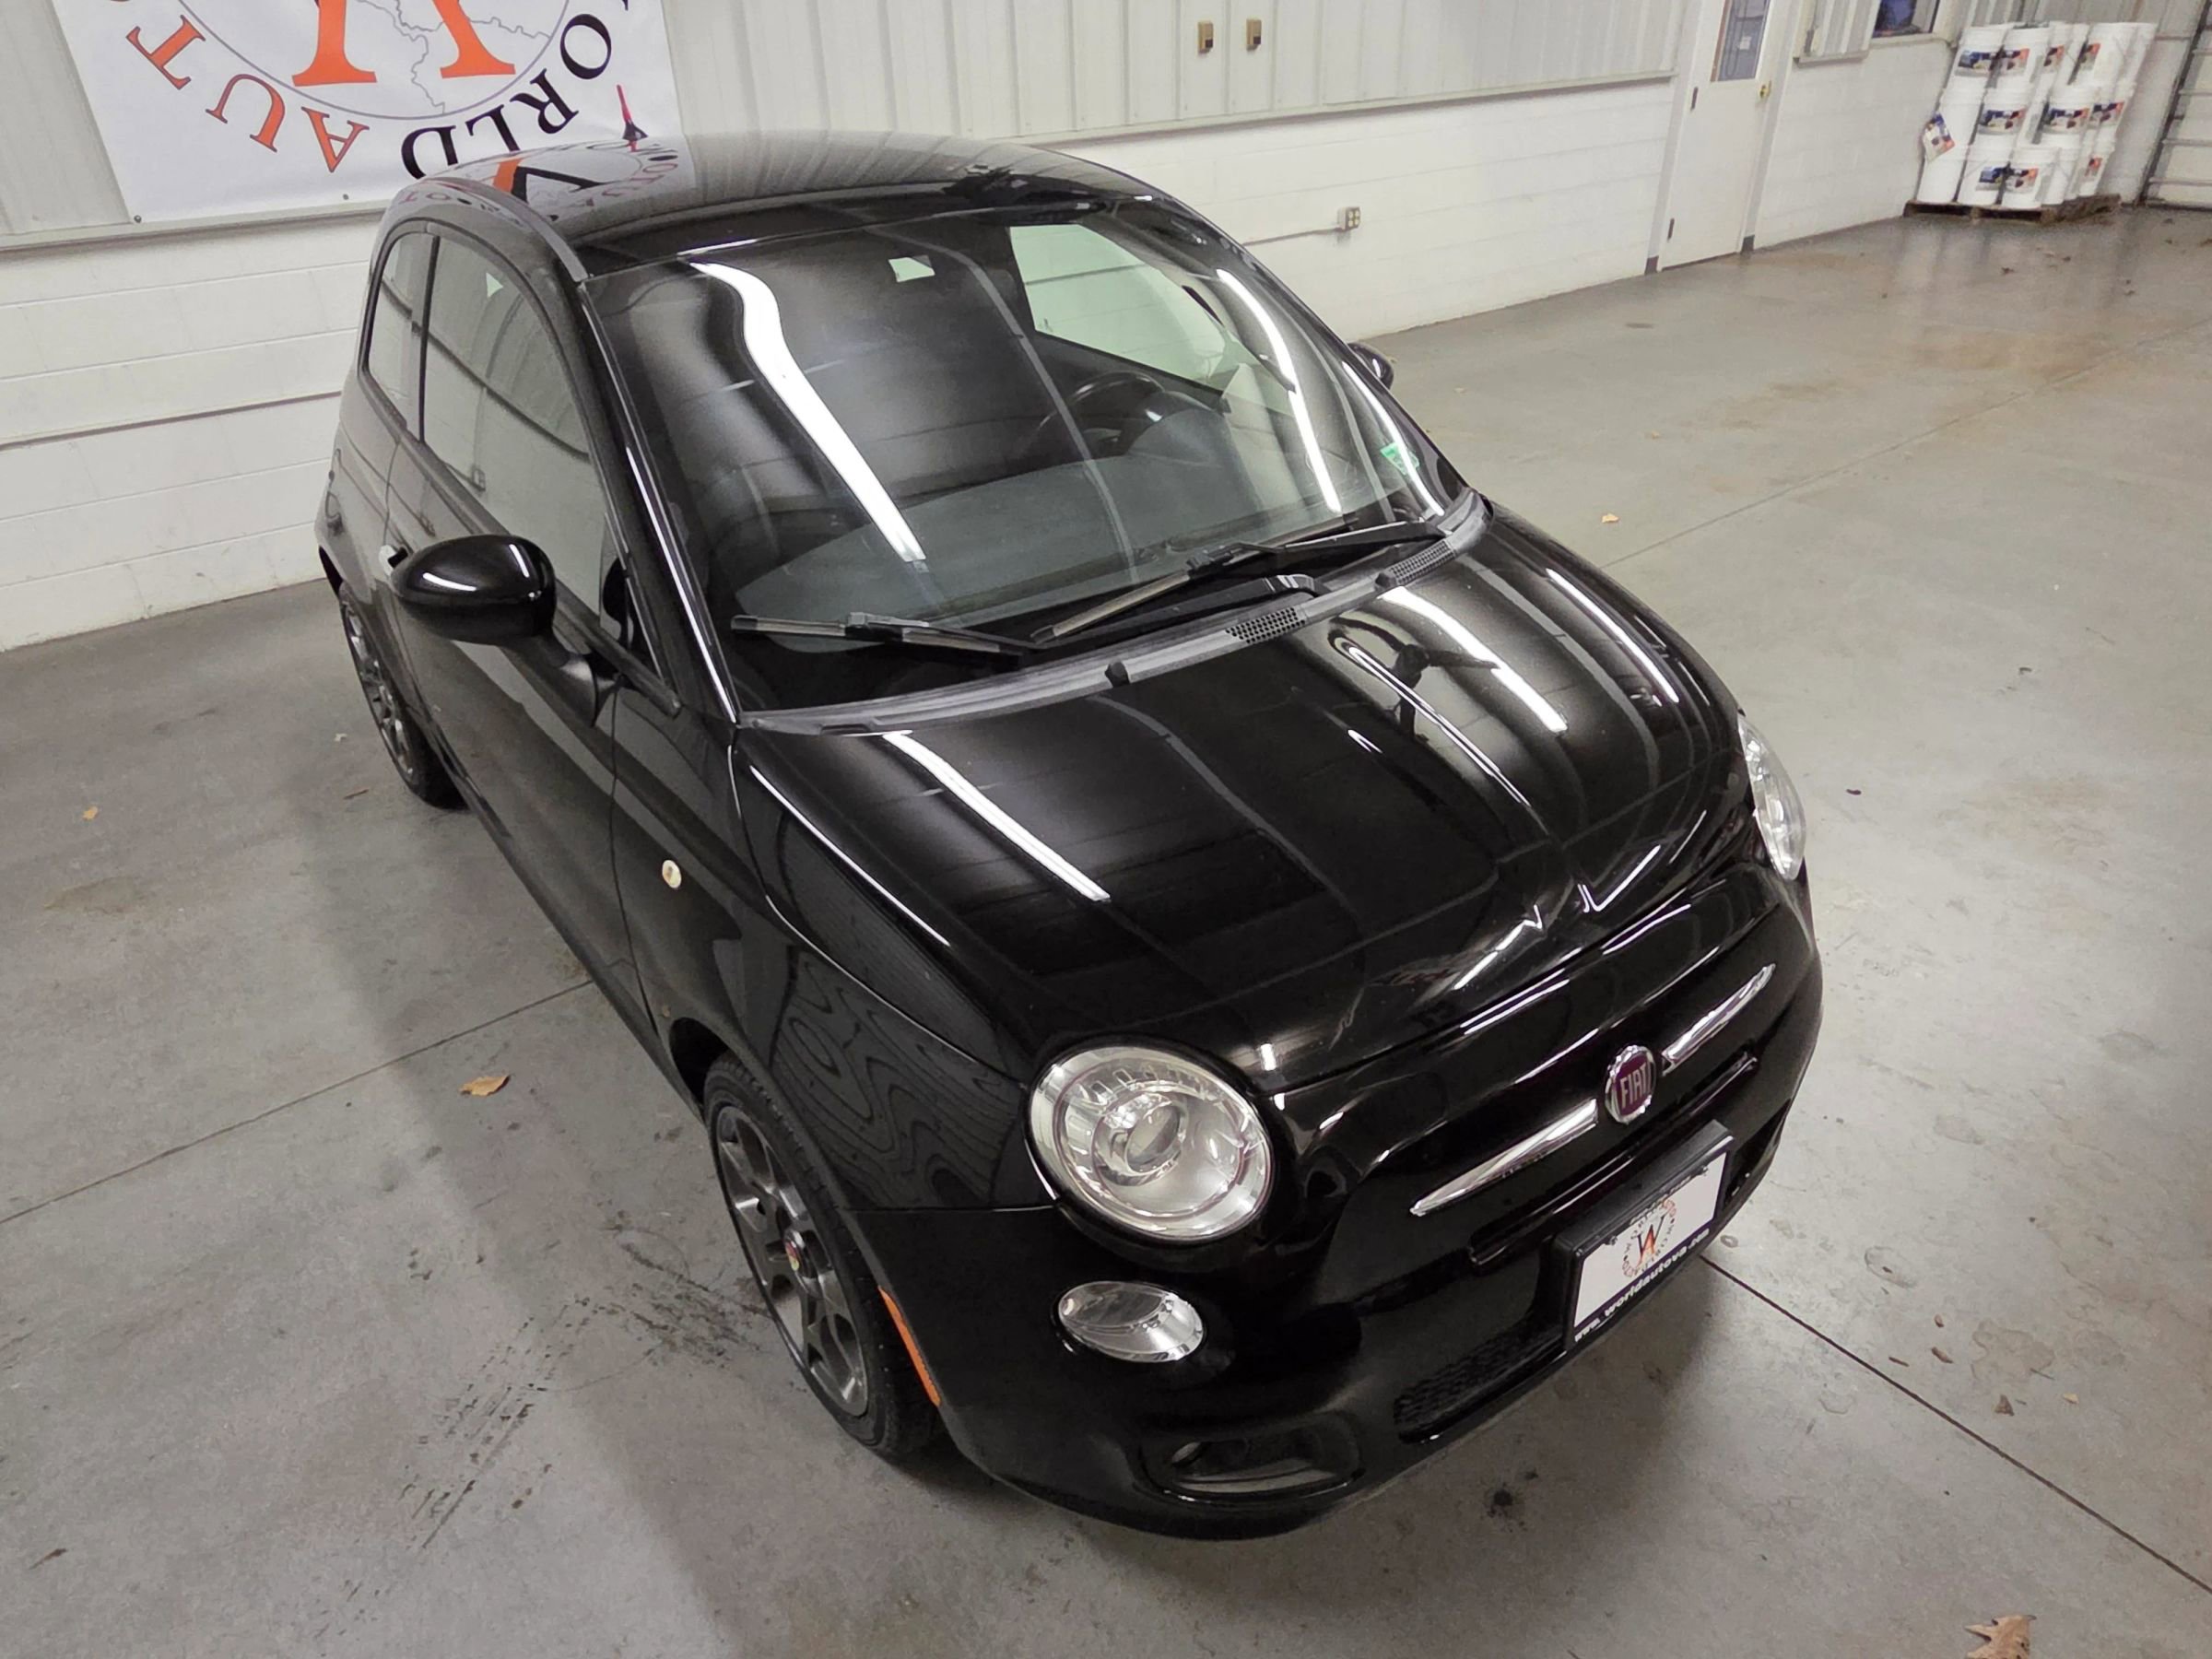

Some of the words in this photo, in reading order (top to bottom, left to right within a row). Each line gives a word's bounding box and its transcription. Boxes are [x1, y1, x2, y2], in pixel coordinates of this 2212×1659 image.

[110, 0, 369, 172] AUT
[401, 0, 629, 179] ORLD
[1619, 1059, 1652, 1109] FIAT
